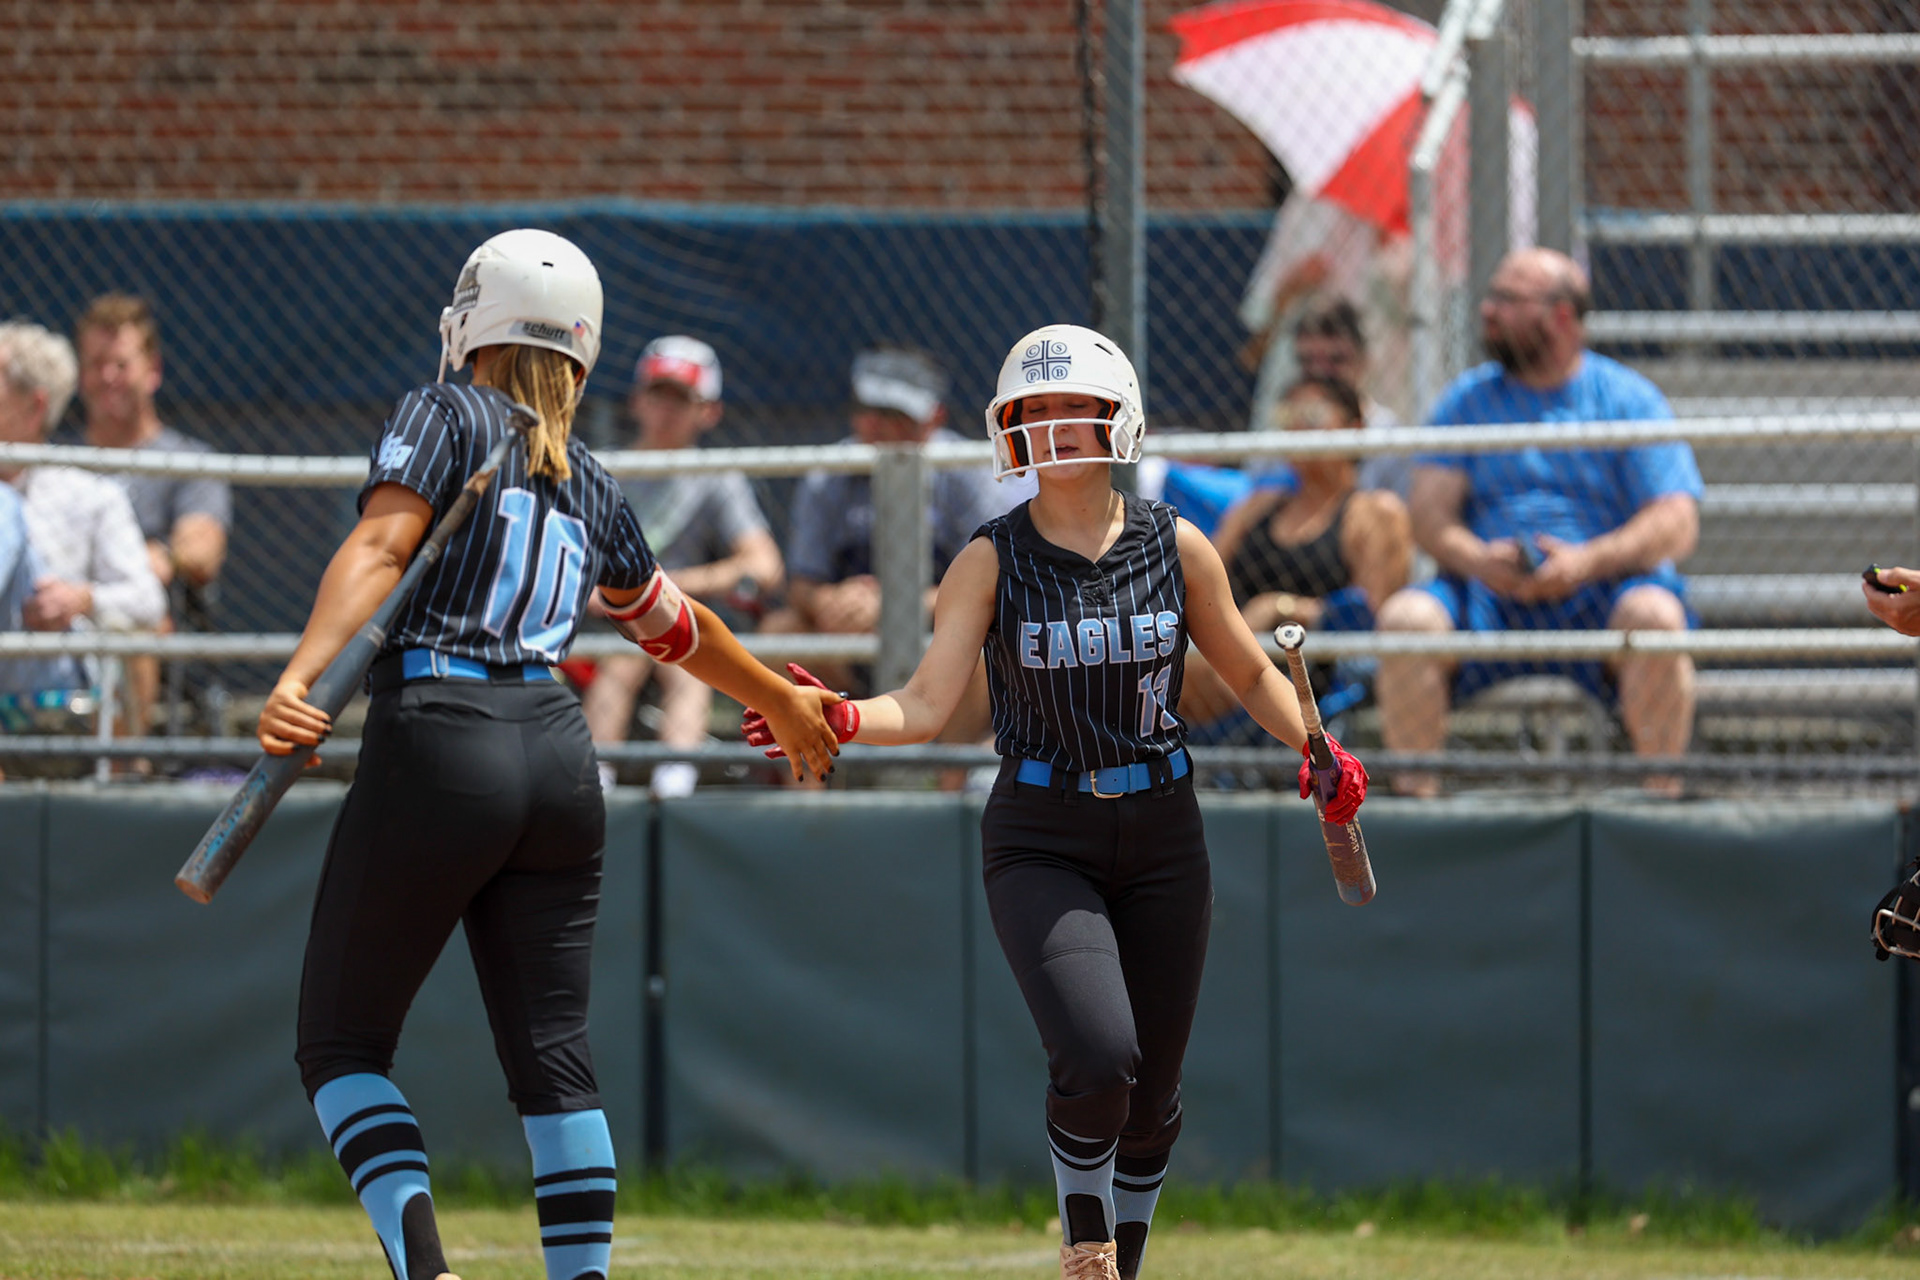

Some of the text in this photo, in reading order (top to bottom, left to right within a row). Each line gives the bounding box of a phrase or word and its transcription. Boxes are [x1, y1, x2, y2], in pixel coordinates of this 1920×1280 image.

[522, 320, 566, 339] schutt
[483, 486, 589, 662] 10
[1019, 610, 1179, 669] EAGLES
